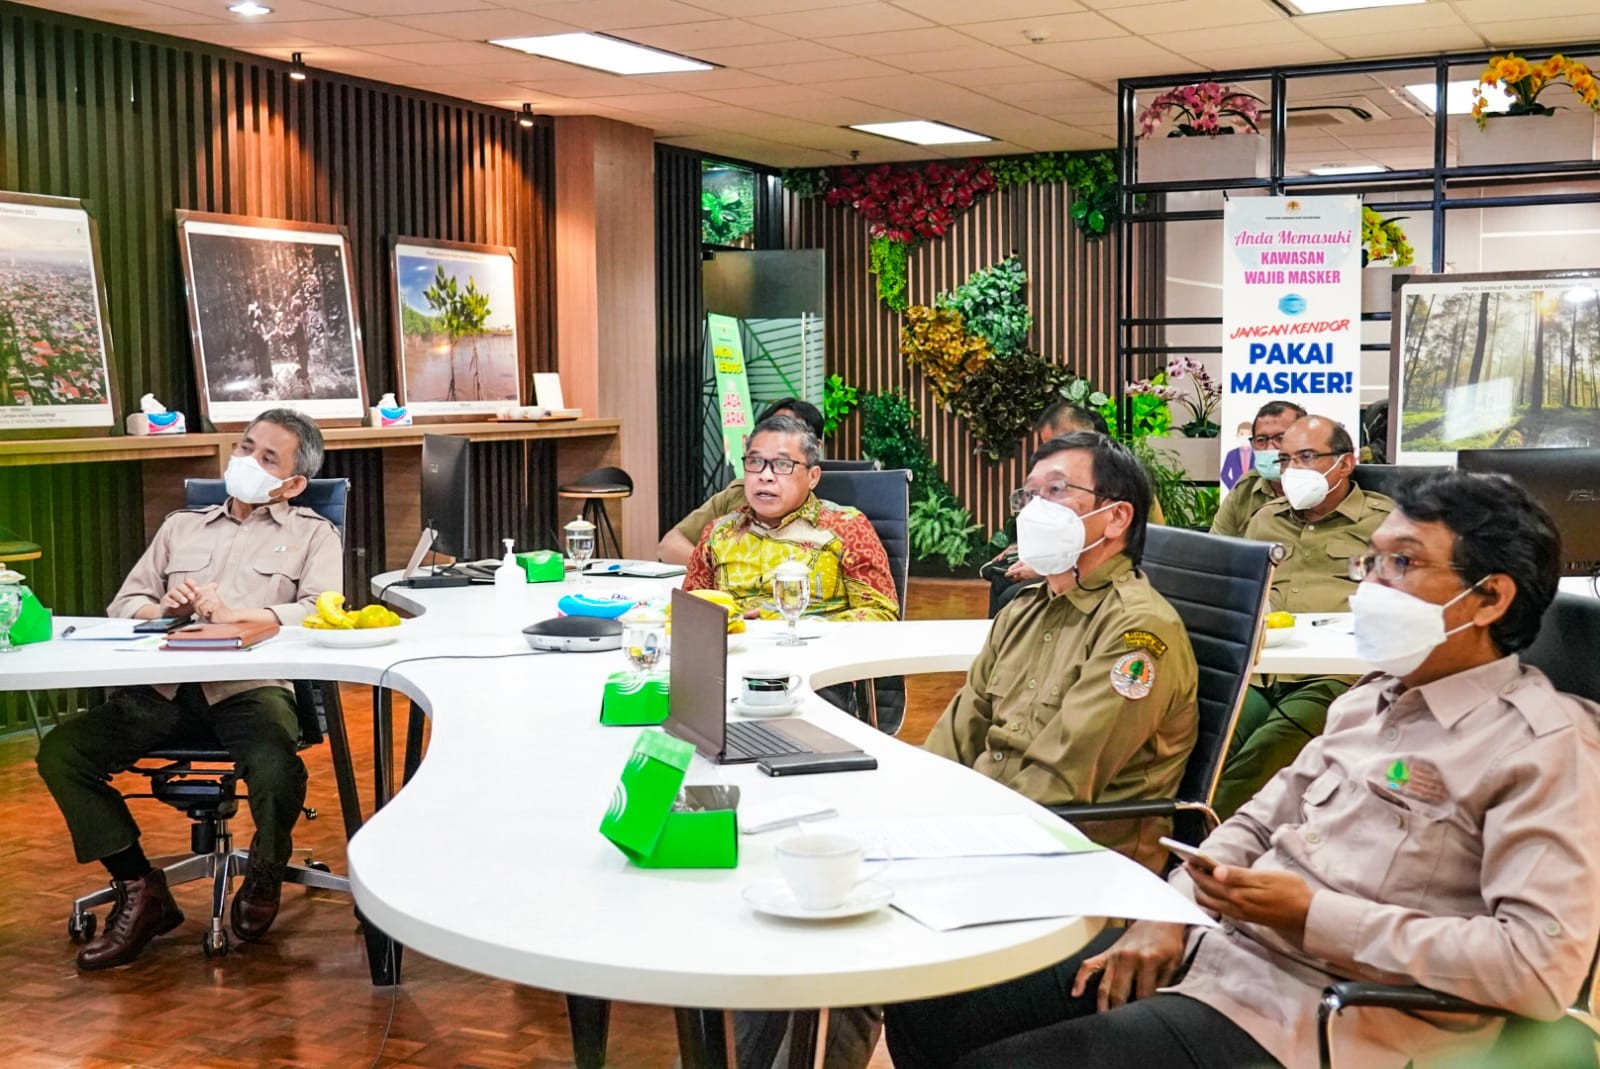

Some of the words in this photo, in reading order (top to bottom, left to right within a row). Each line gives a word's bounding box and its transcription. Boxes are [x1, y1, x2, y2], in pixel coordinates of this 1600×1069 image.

[1234, 230, 1273, 247] Anda
[1277, 230, 1353, 244] Memasuki
[1261, 251, 1325, 265] KAWASAN
[1244, 271, 1285, 285] WAJIB
[1288, 270, 1341, 284] MASKER
[1230, 323, 1289, 340] JANGAN
[1290, 319, 1351, 336] KENDOR
[1249, 342, 1333, 364] PAKAI
[1231, 371, 1353, 394] MASKER!
